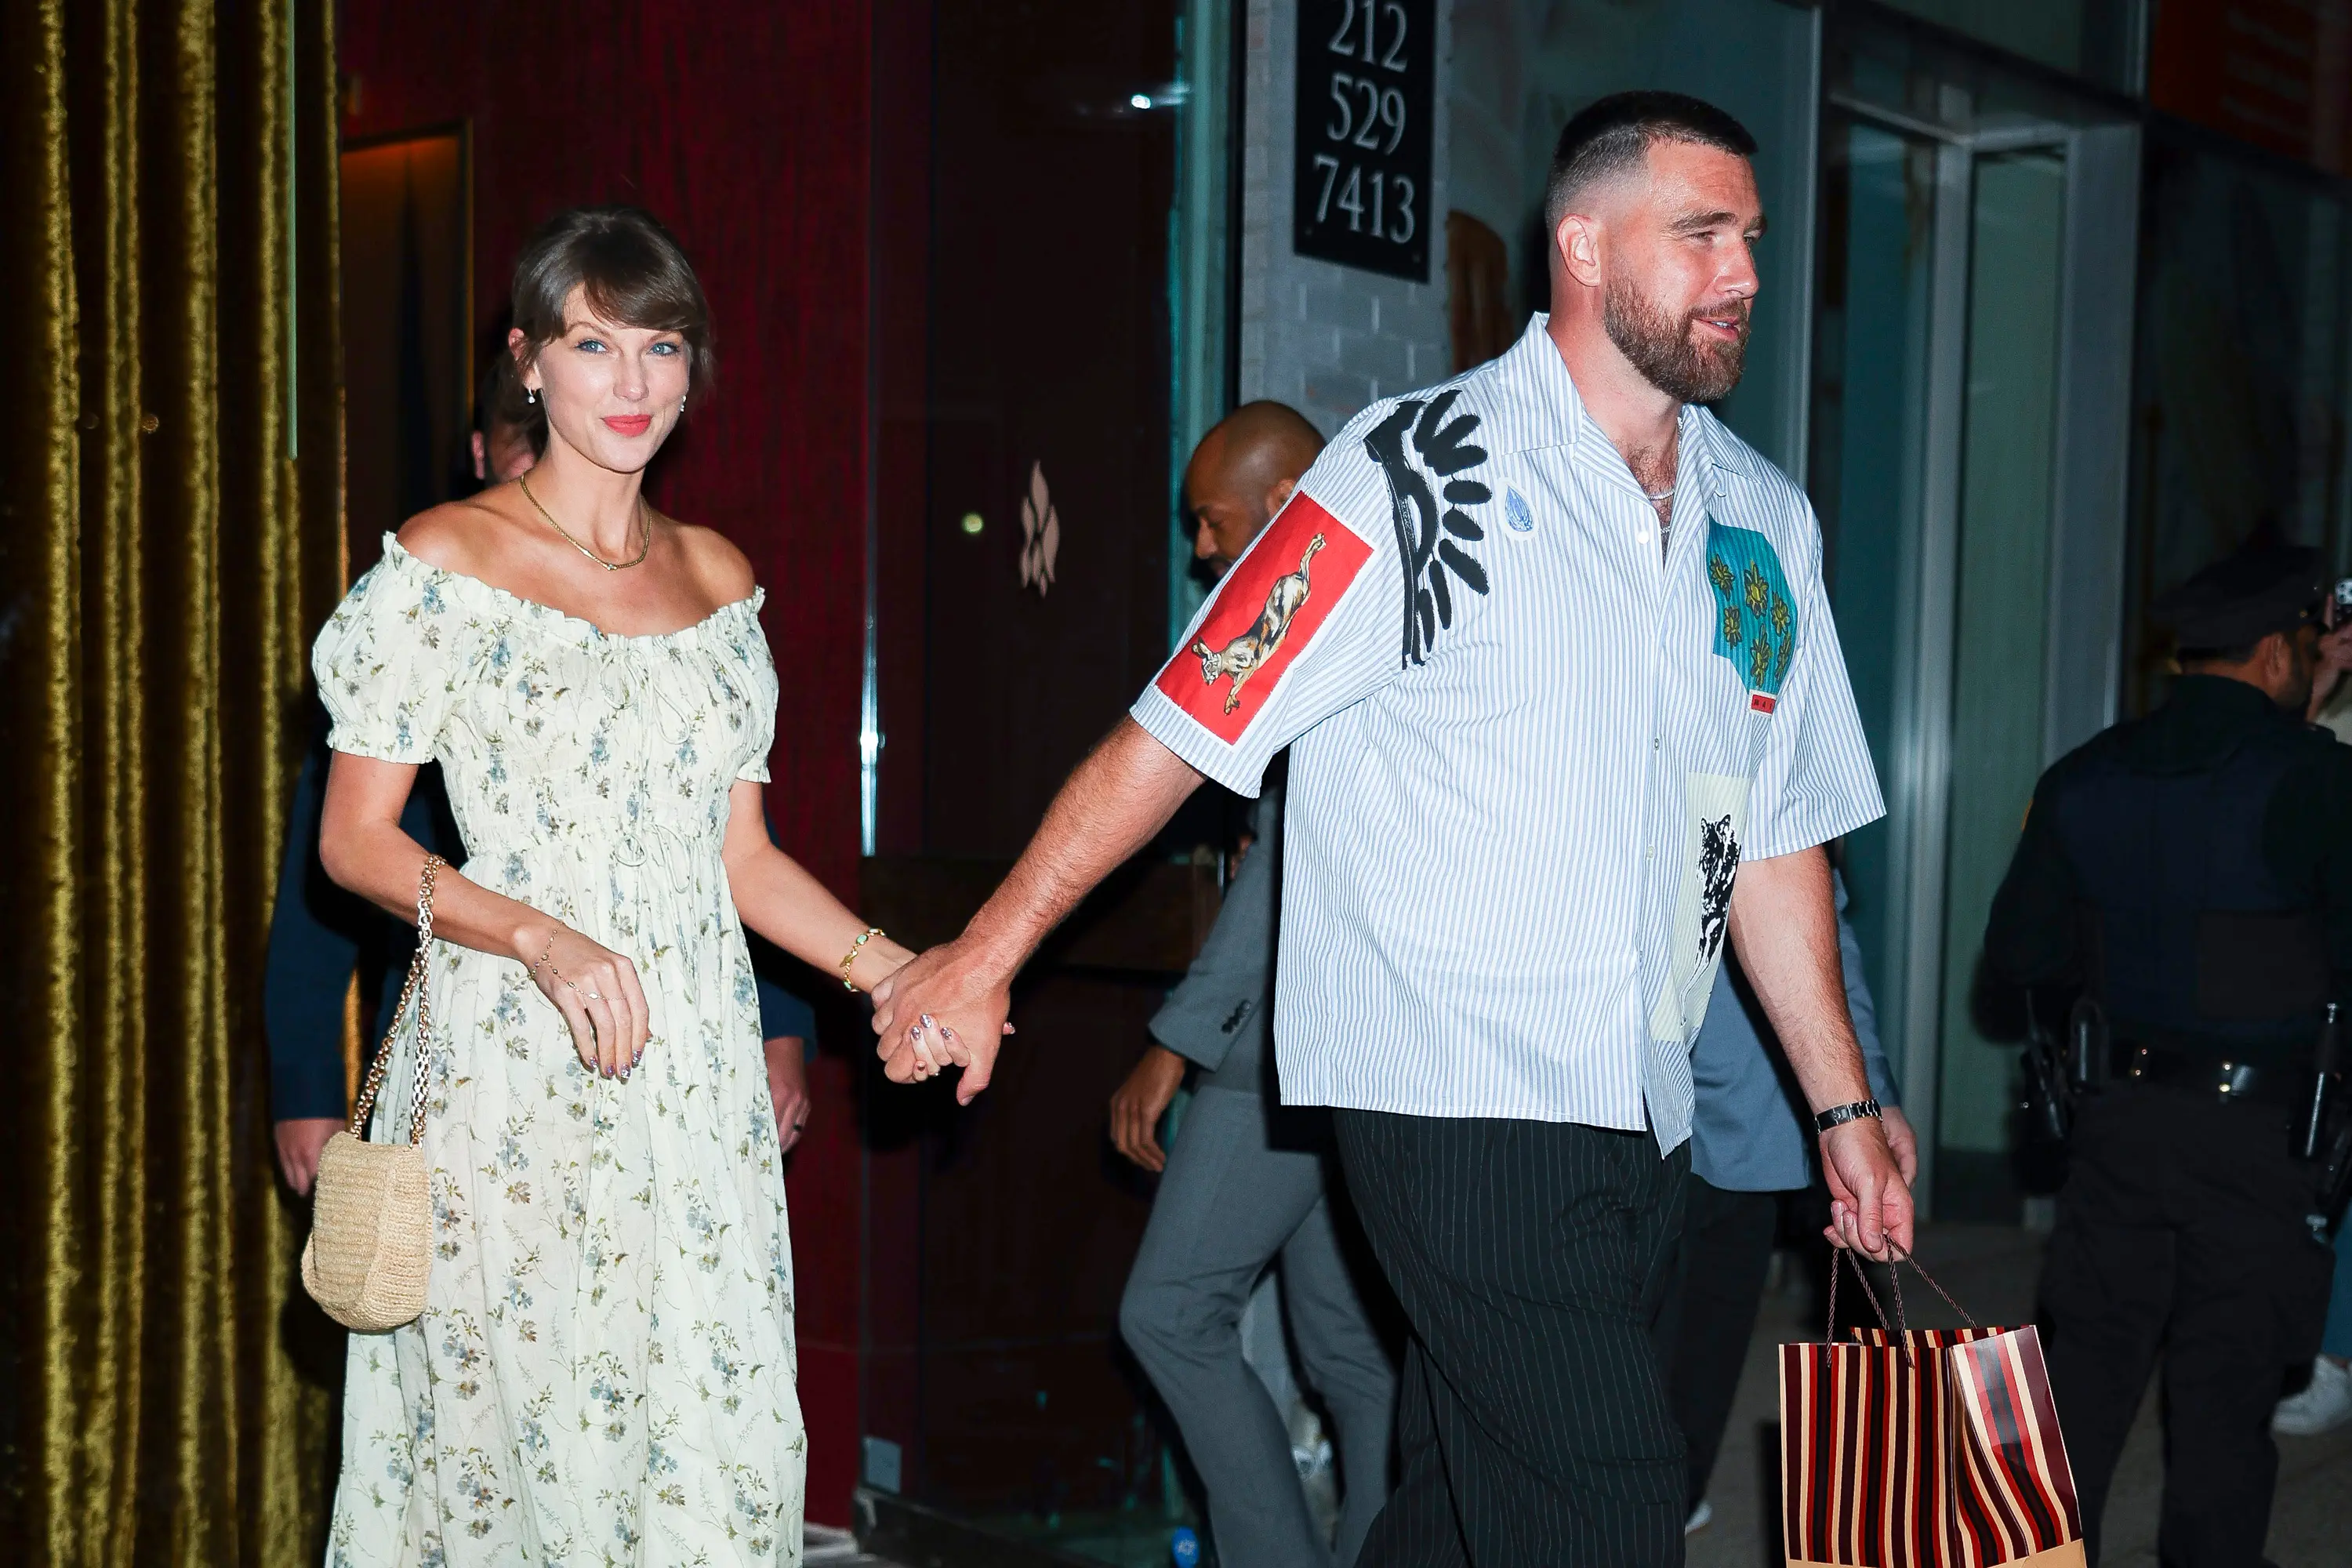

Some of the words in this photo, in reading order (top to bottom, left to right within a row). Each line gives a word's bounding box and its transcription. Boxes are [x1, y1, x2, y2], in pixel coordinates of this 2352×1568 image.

[1328, 0, 1407, 72] 212
[1327, 72, 1406, 155] 529
[1313, 154, 1414, 244] 7413
